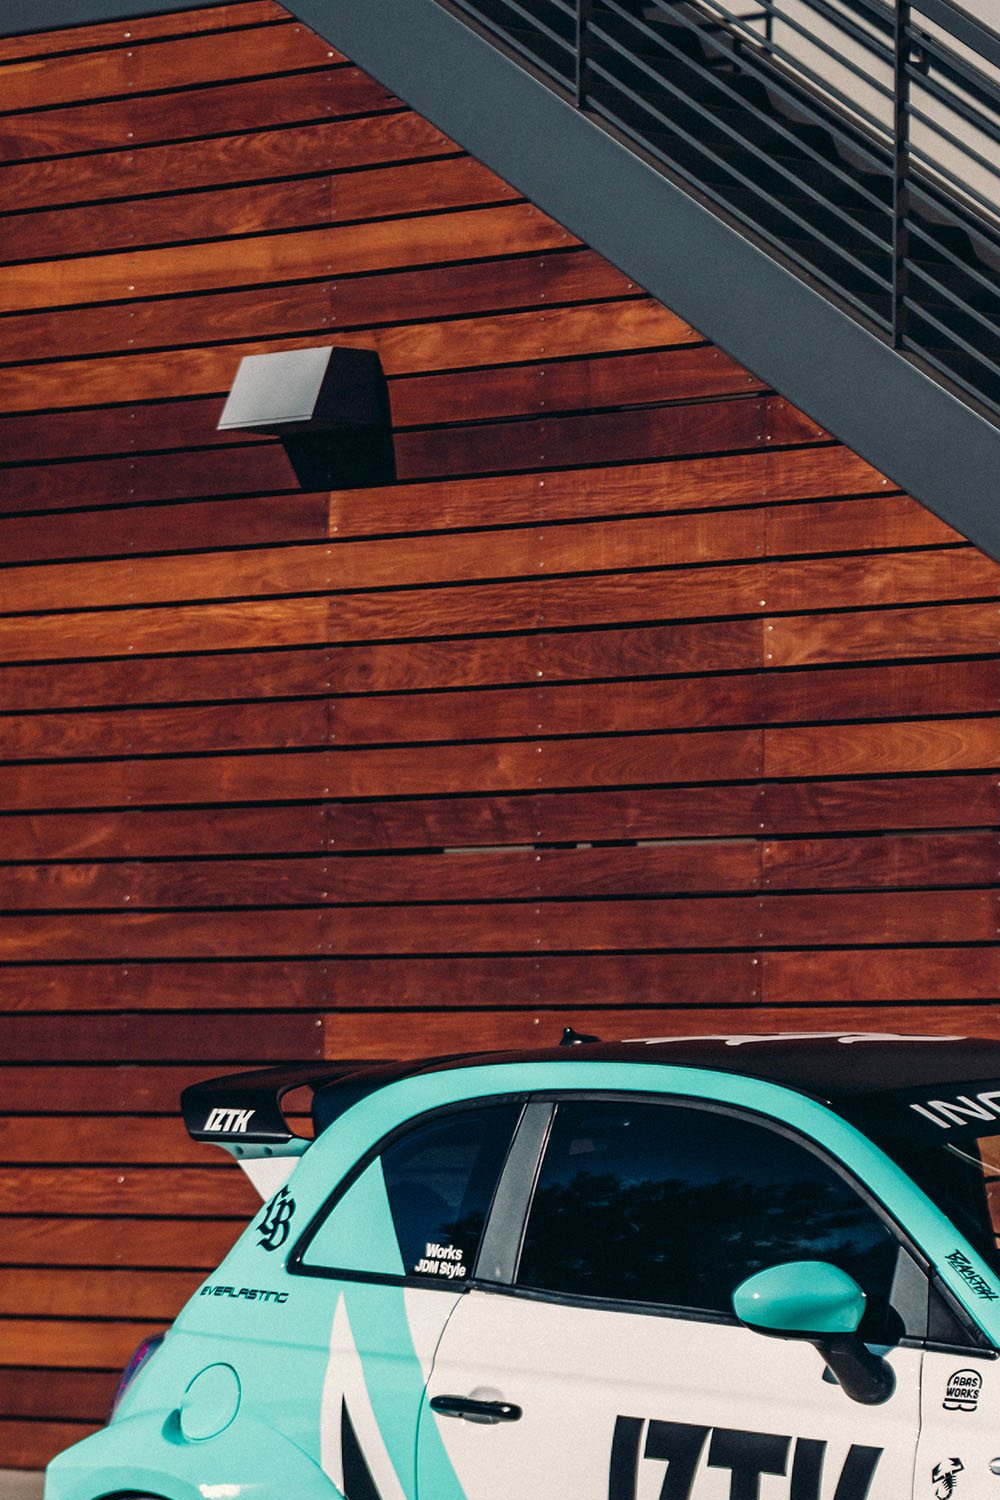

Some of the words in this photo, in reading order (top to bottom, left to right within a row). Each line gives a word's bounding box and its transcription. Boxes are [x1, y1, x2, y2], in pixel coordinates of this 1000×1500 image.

[203, 1108, 256, 1132] IZTK
[426, 1242, 463, 1261] Works
[414, 1259, 440, 1274] JDM
[439, 1261, 467, 1280] Style
[200, 1286, 289, 1303] EVERLASTING
[953, 1376, 978, 1387] ABAS
[946, 1387, 980, 1399] WORKS
